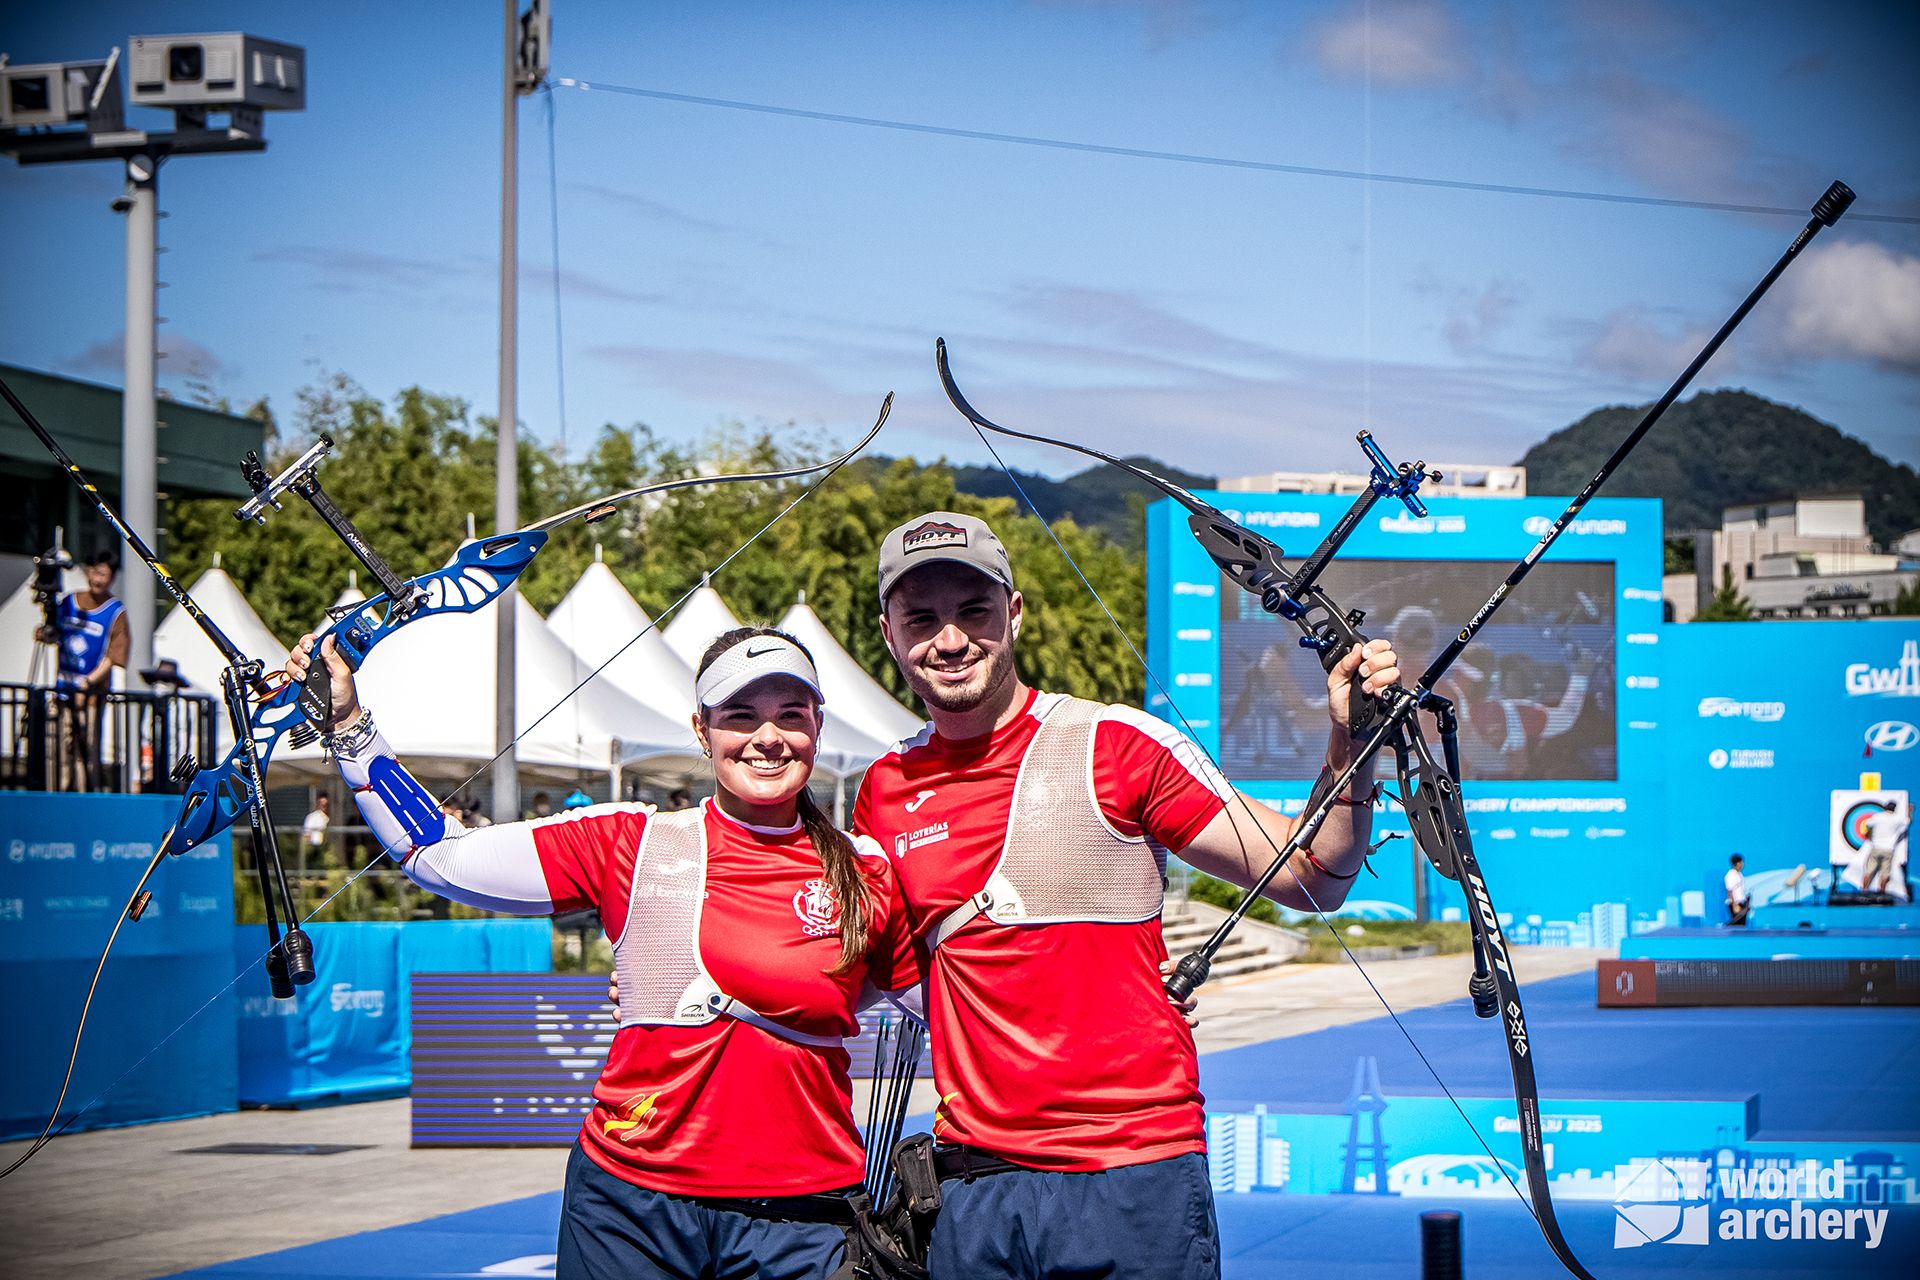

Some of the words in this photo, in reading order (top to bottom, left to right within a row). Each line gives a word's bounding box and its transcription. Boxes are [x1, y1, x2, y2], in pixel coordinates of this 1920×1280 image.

[908, 530, 960, 546] HOYT
[1563, 519, 1627, 534] YUNDAI
[347, 532, 369, 558] AXCEL
[1468, 581, 1509, 629] RAMRODS
[909, 821, 949, 841] LOTERÍAS
[1468, 872, 1513, 982] HOYT
